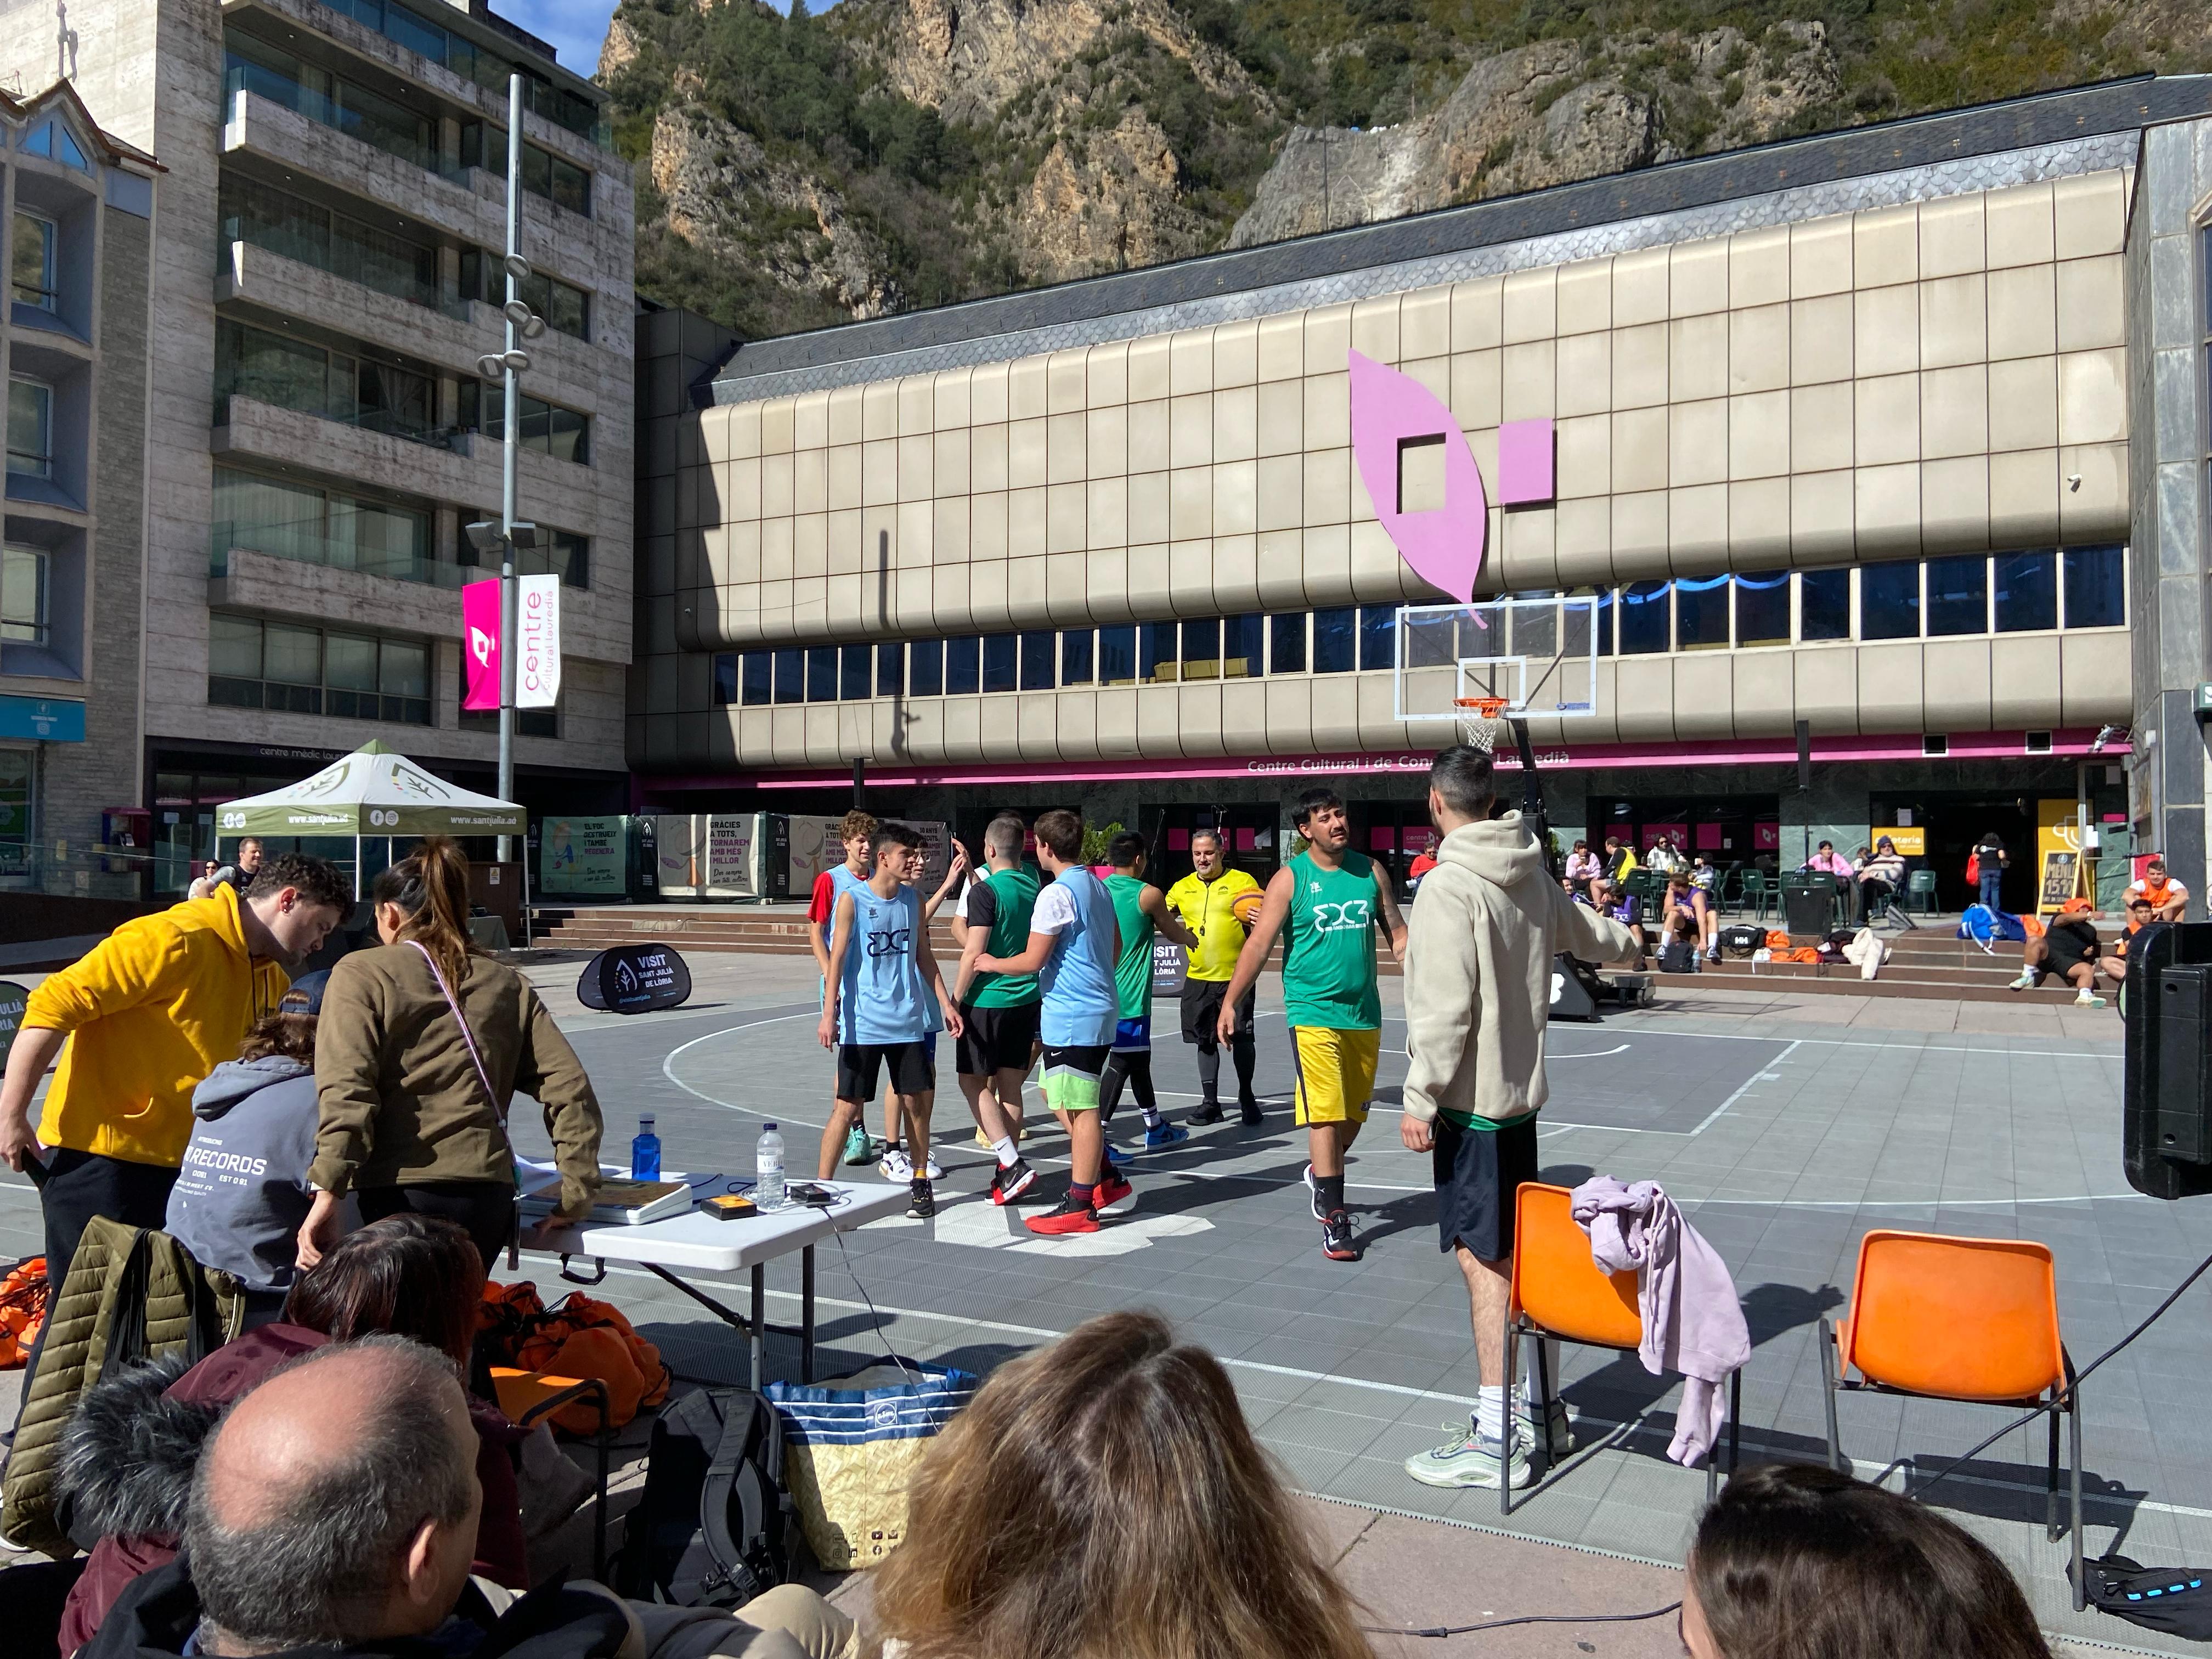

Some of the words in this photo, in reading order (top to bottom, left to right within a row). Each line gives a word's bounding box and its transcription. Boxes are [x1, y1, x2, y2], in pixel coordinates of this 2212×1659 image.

[545, 591, 554, 640] lauredià
[525, 592, 541, 691] centre
[542, 645, 554, 691] cultural
[260, 747, 289, 757] centre
[1248, 760, 1296, 772] Centre
[1301, 758, 1359, 771] Cultural
[1365, 757, 1369, 769] i
[1374, 757, 1393, 768] de
[1496, 751, 1570, 765] Lauedià
[710, 820, 741, 829] GRÀCIES
[717, 830, 737, 838] TOTS,
[726, 846, 742, 855] MÉS
[1153, 945, 1178, 957] ISIT
[637, 953, 666, 968] VISIT
[1159, 957, 1181, 966] JULIÀ
[638, 970, 654, 979] SANT
[1154, 967, 1176, 975] LÒRIA
[654, 977, 673, 986] LÒRIA
[0, 998, 24, 1015] ULIÀ
